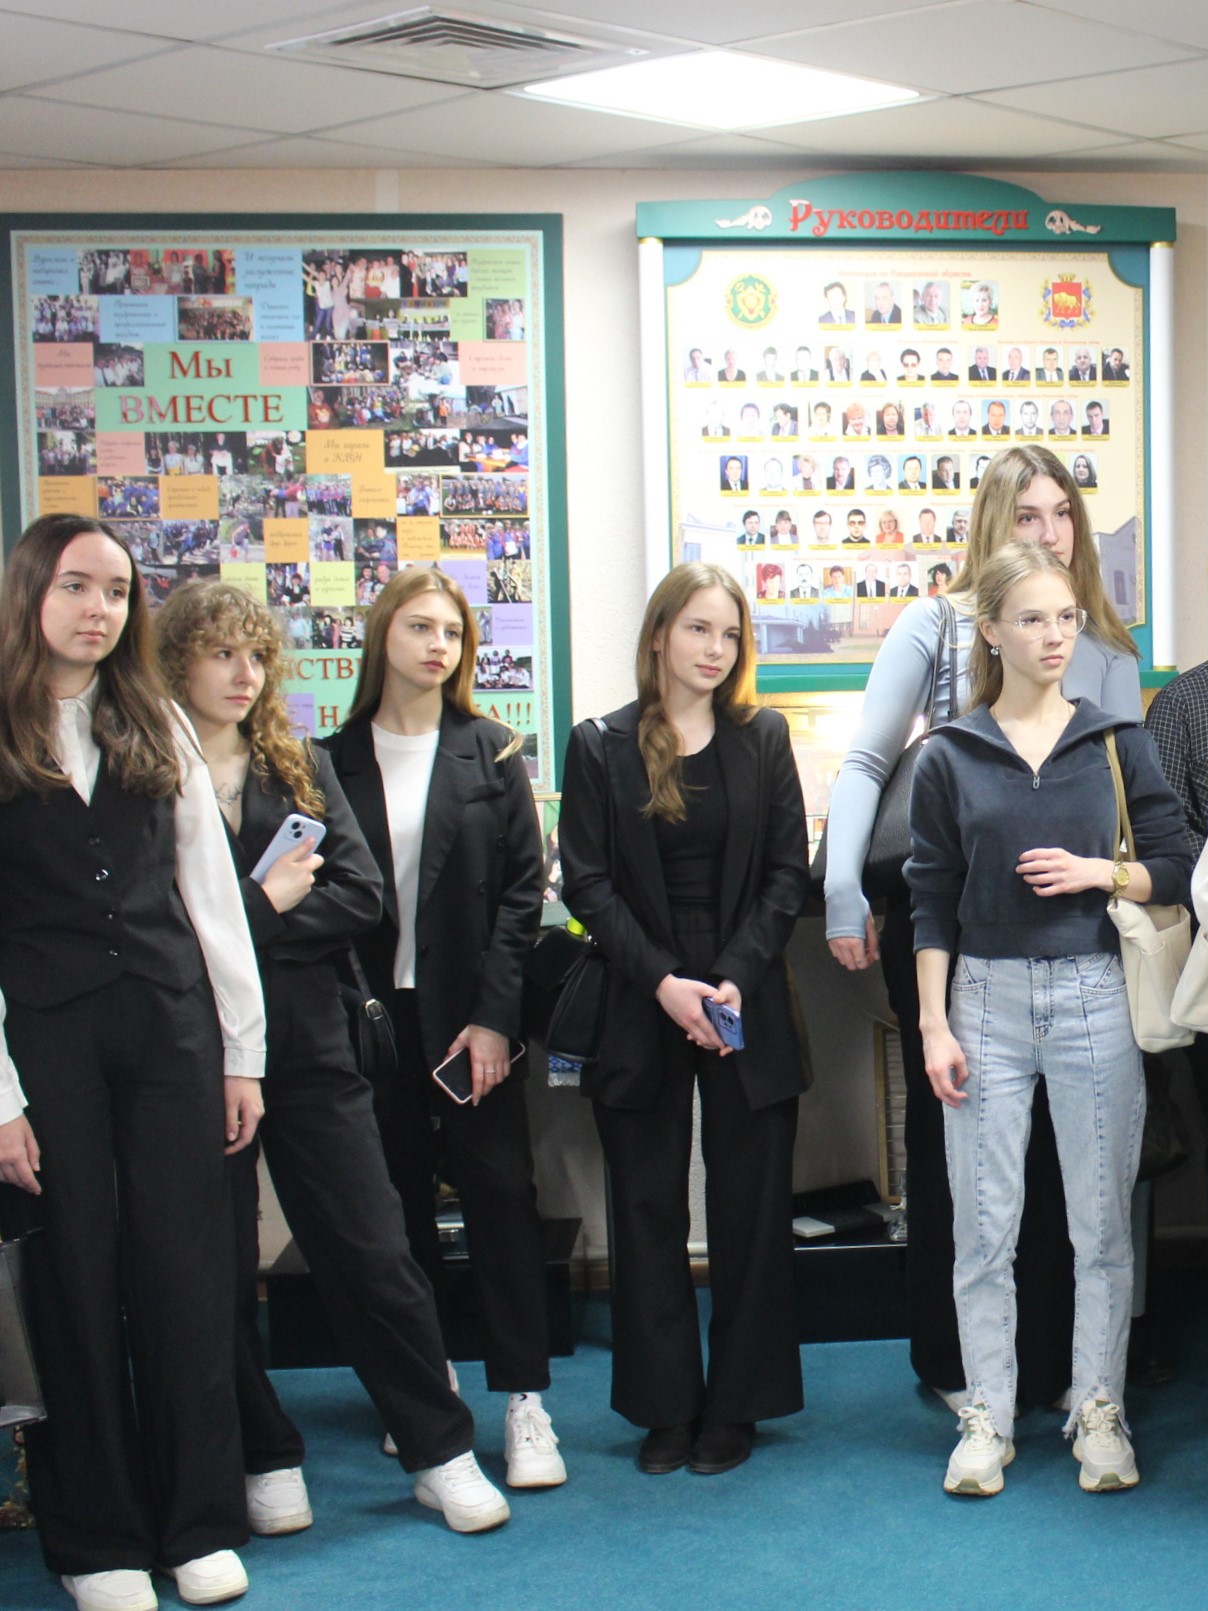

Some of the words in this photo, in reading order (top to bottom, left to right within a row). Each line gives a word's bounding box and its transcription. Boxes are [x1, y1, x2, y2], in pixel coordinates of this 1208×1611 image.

[788, 199, 1029, 237] Руководители
[168, 350, 233, 379] Мы
[118, 394, 284, 424] ВМЕСТЕ
[286, 656, 363, 681] СТВ
